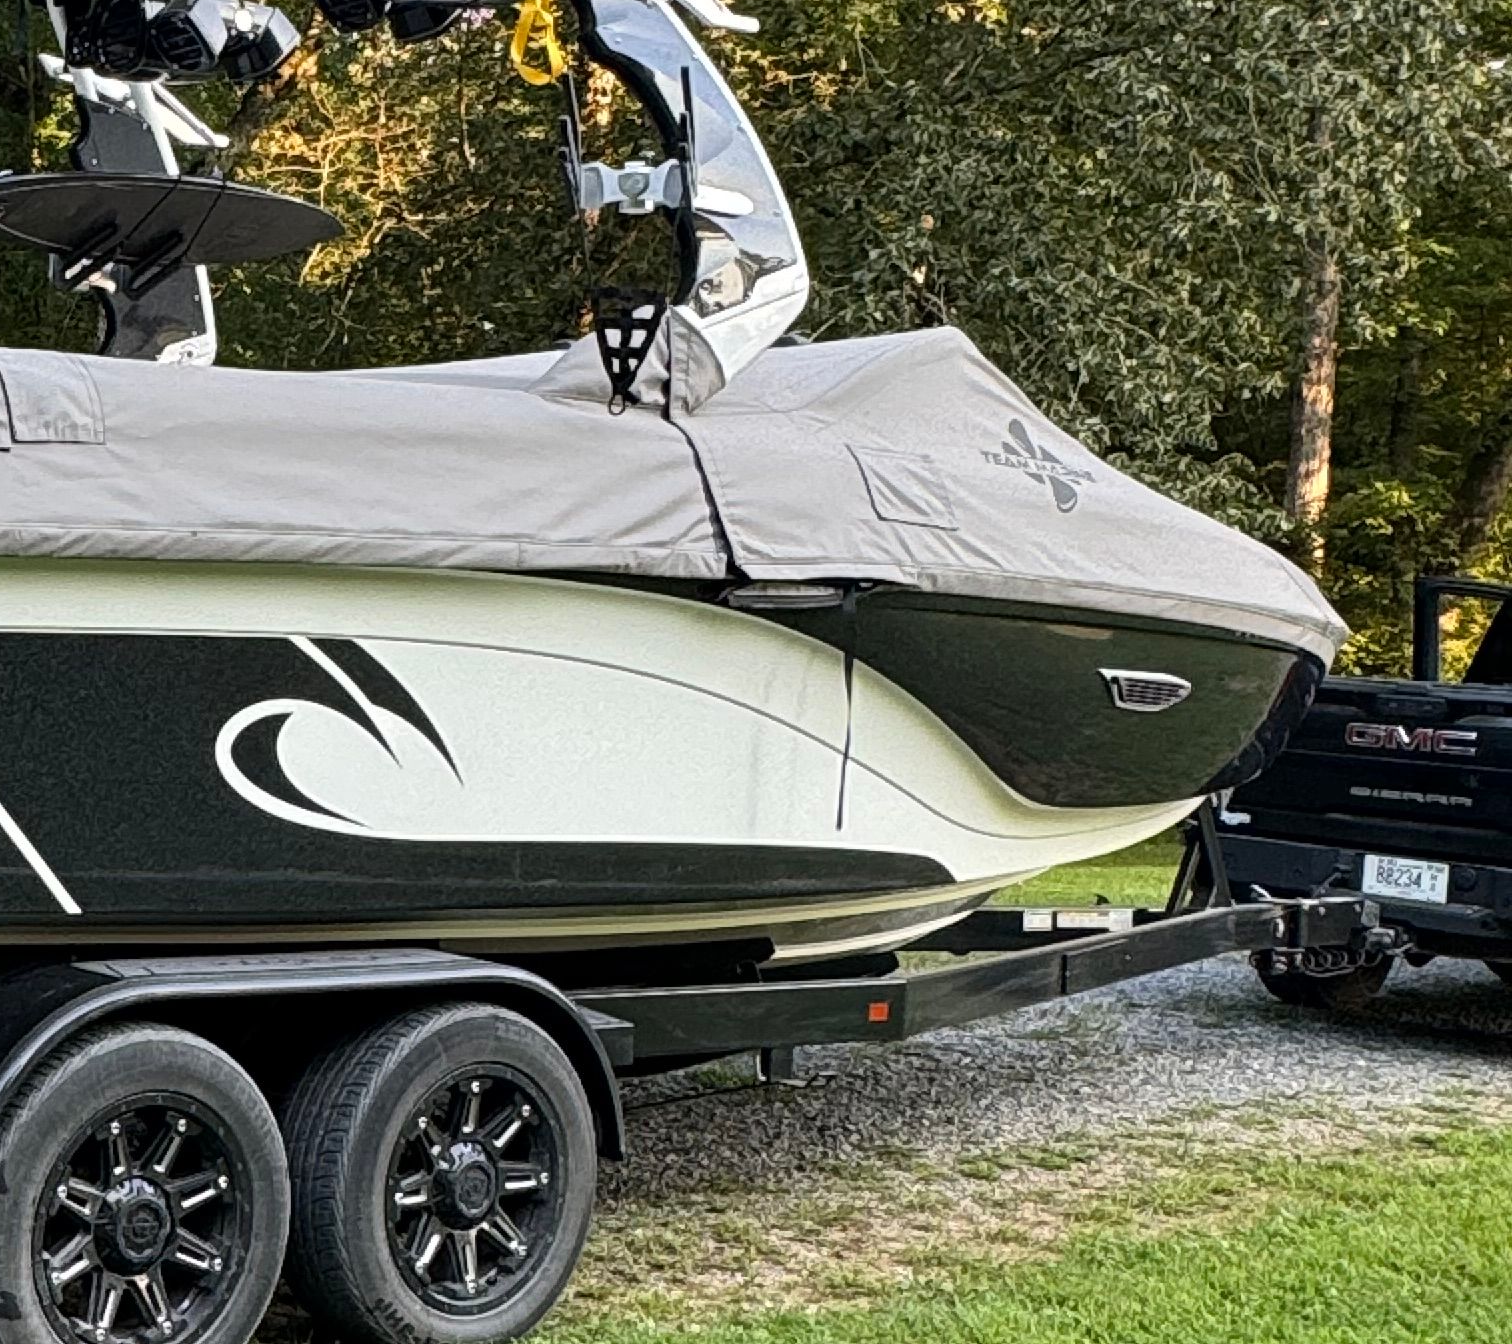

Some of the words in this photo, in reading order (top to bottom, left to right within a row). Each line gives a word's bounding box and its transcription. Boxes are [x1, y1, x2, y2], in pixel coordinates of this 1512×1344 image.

[979, 450, 1029, 470] TEAM
[1344, 722, 1478, 757] GMC
[1349, 785, 1474, 807] SIERRA
